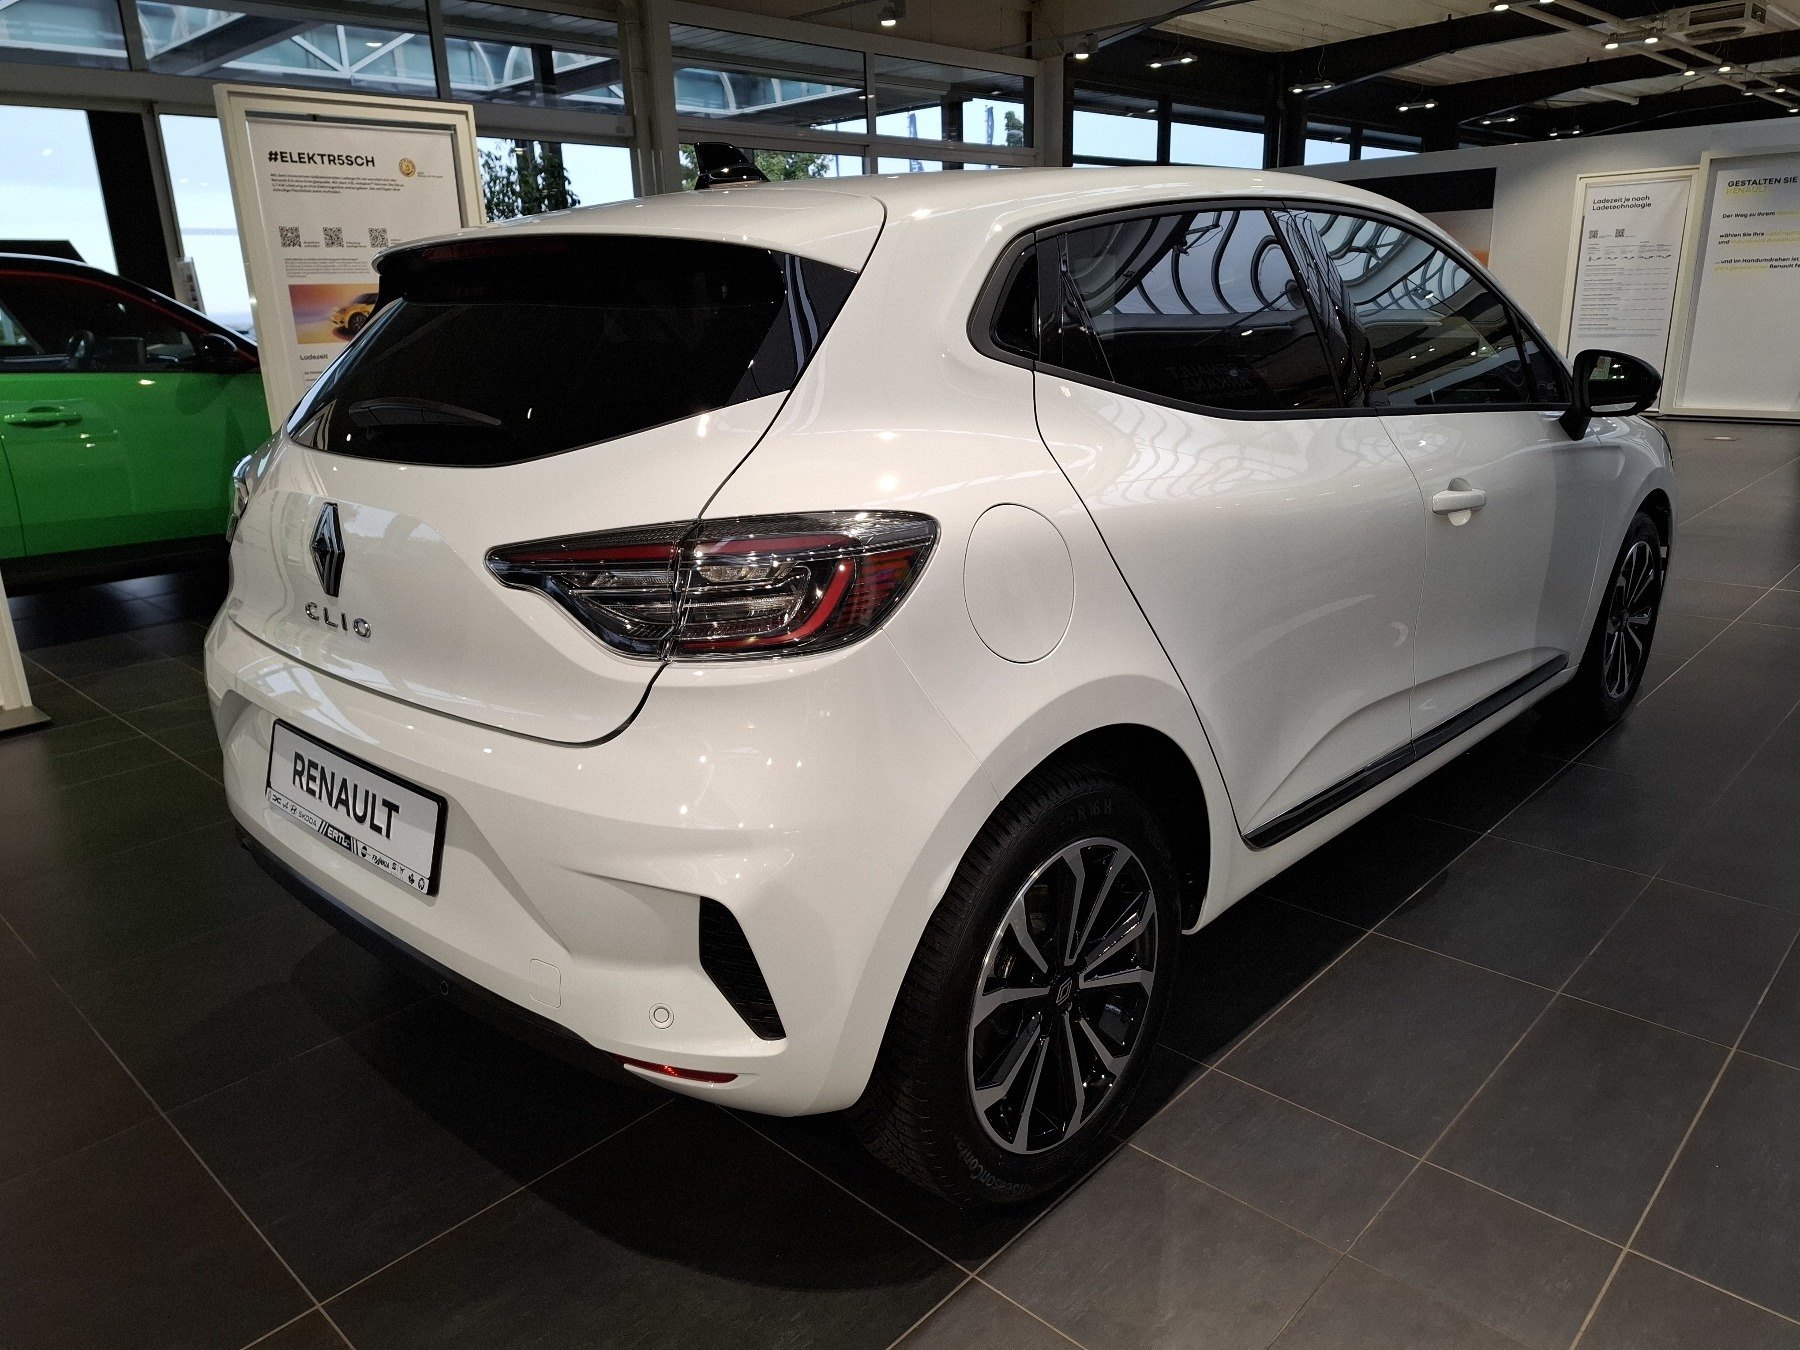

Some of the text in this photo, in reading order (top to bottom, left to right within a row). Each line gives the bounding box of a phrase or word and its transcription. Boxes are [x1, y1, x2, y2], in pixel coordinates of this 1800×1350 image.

[267, 150, 376, 167] #ELEKTR5SCH
[1728, 176, 1799, 187] GESTALTEN SIE
[1592, 202, 1652, 211] Ladetechnologie
[300, 353, 329, 361] Ladezeit
[304, 601, 372, 639] CLIO
[292, 750, 400, 841] RENAULT
[327, 826, 348, 846] ERTL
